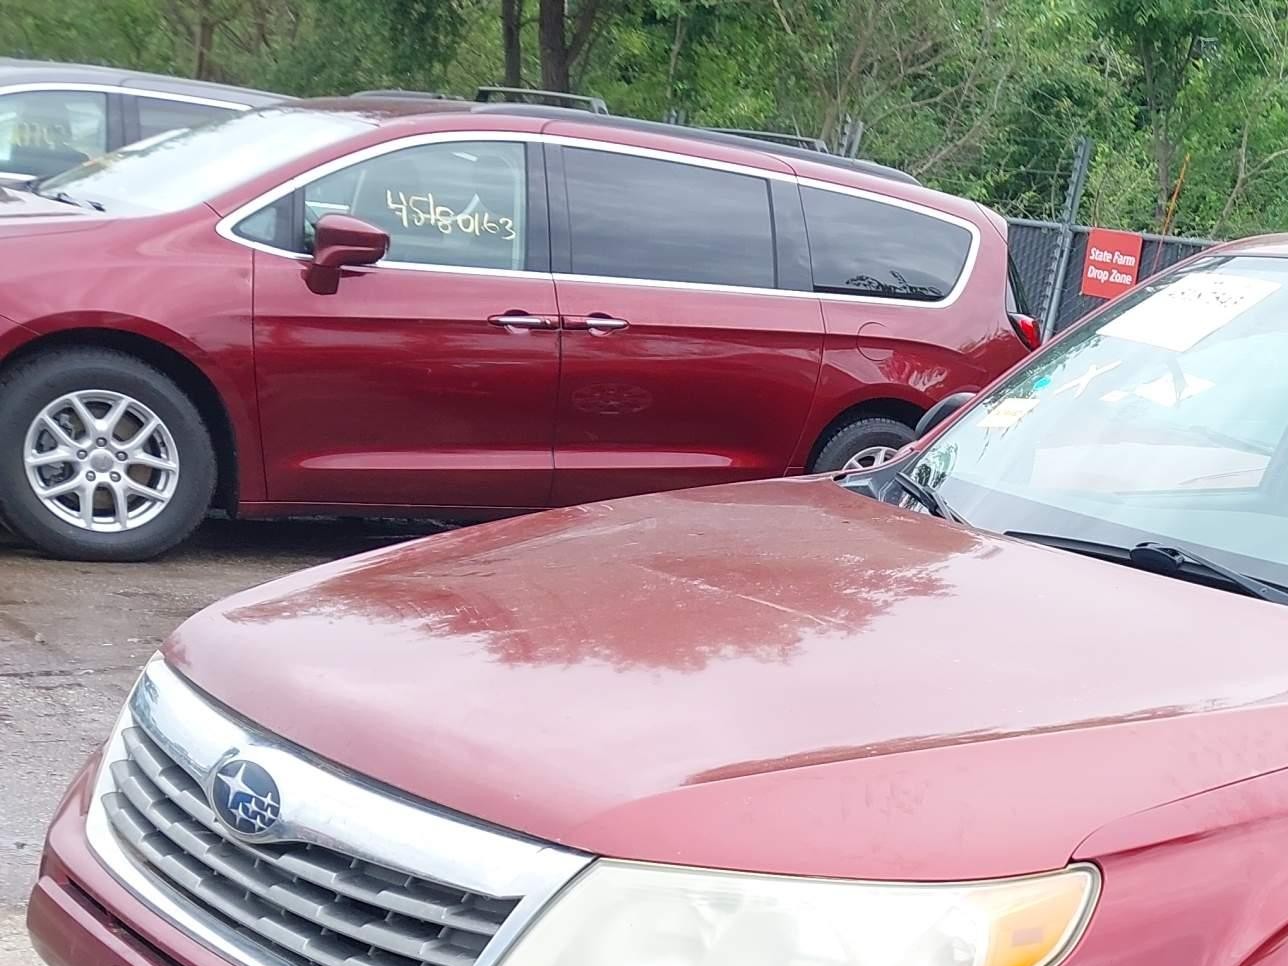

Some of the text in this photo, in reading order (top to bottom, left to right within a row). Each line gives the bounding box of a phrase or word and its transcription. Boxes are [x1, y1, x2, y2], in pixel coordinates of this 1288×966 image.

[1089, 247, 1136, 266] State Farm
[1087, 265, 1133, 285] Drop Zone
